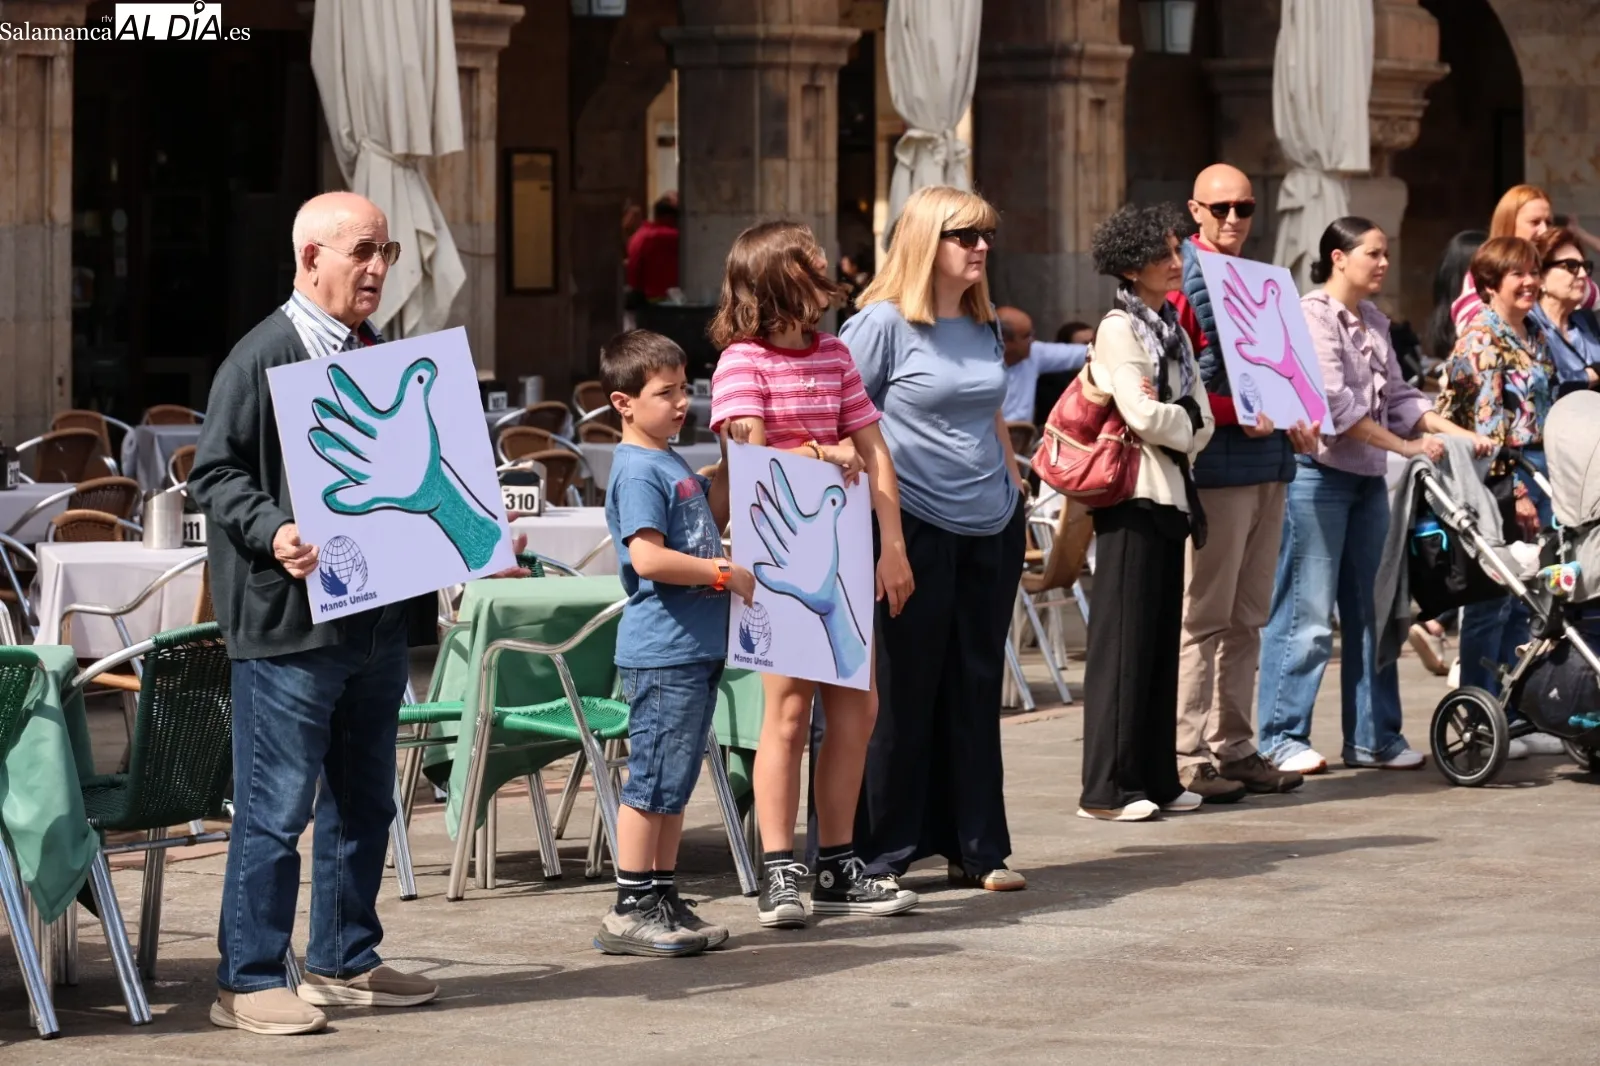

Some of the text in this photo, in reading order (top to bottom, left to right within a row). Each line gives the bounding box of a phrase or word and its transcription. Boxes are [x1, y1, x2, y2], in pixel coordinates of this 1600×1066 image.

[505, 493, 535, 510] 310
[320, 590, 378, 613] Manos Unidas
[734, 653, 774, 668] Manos Unidas
